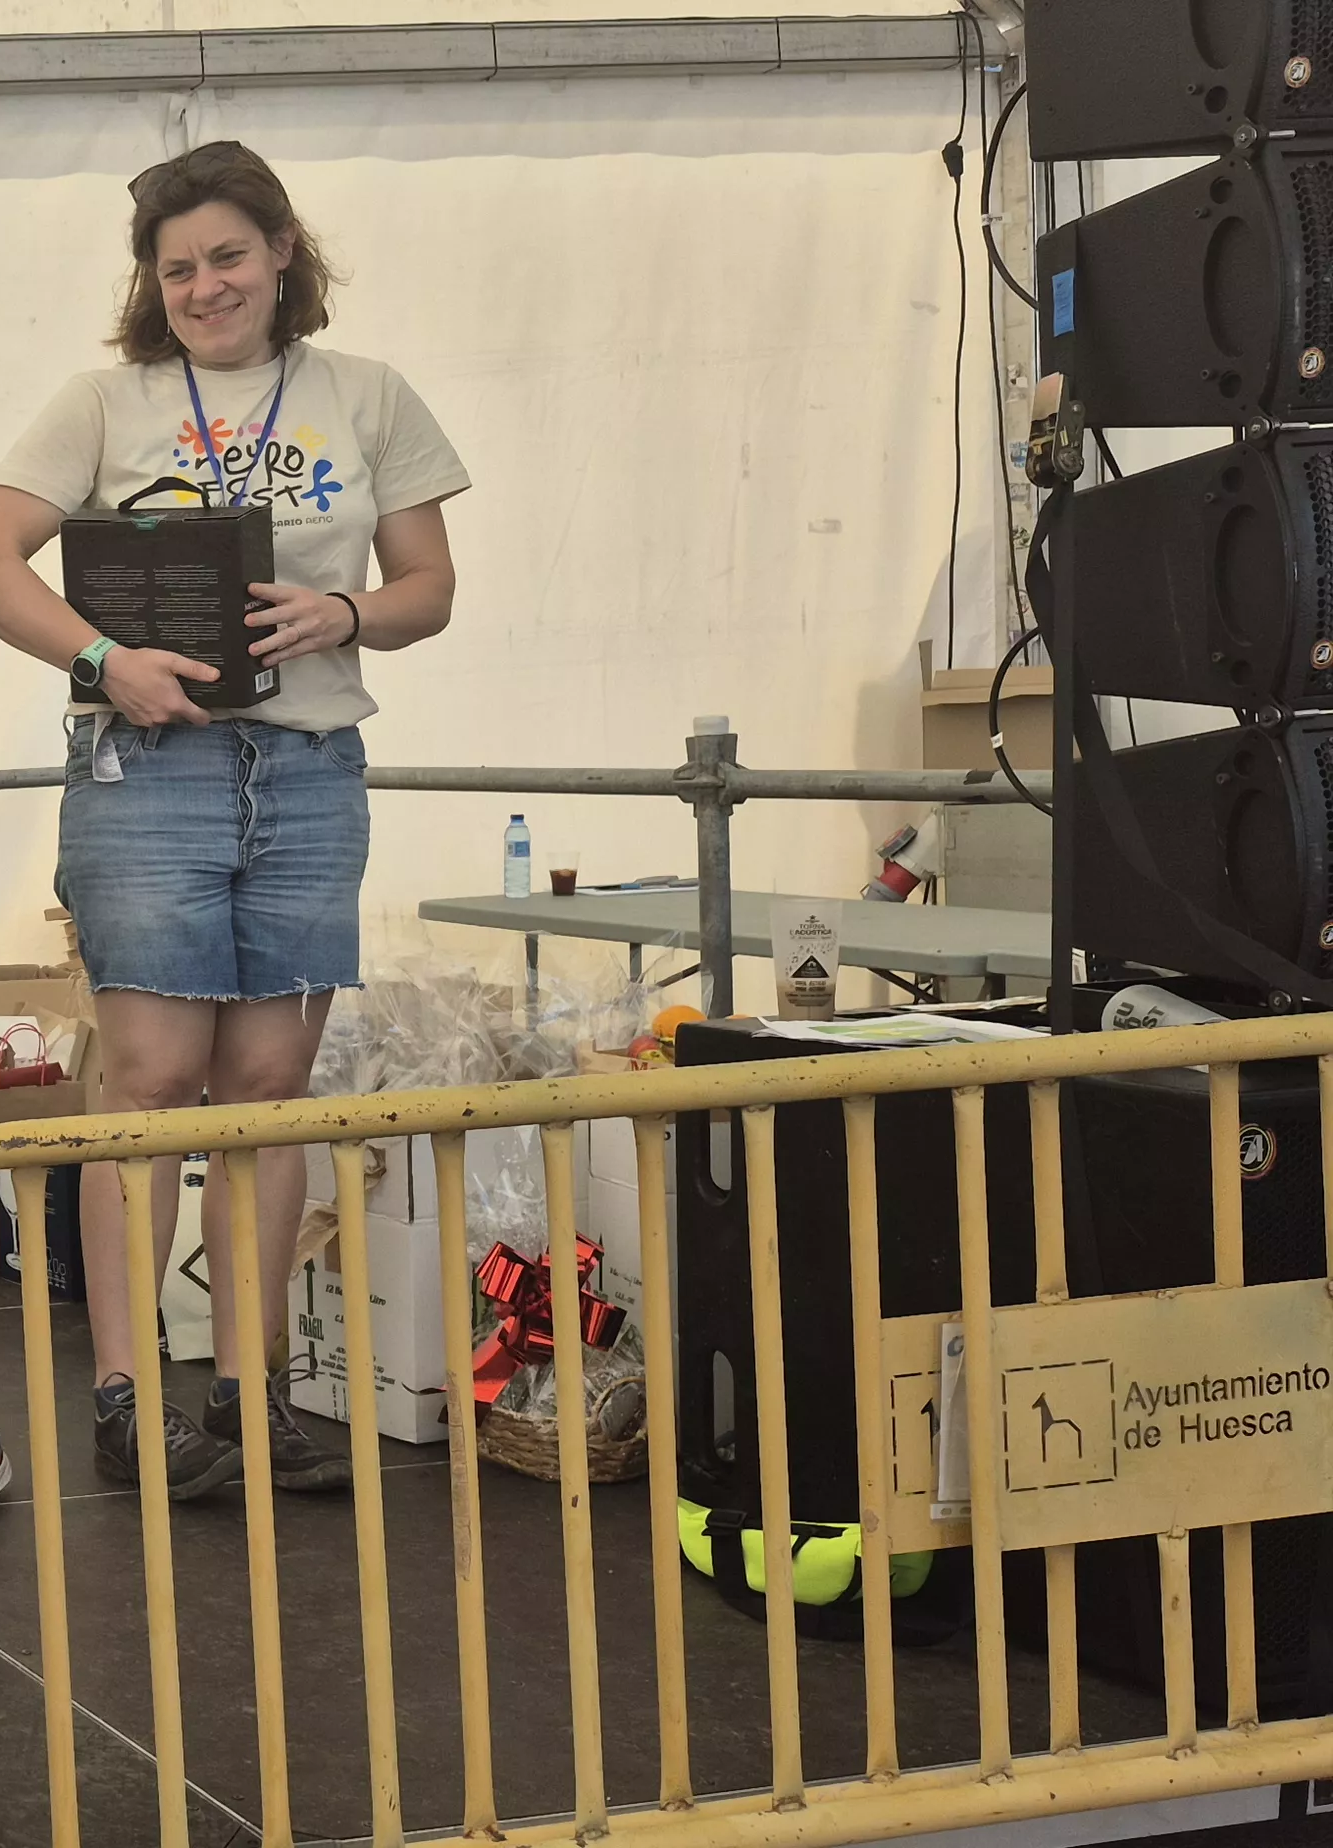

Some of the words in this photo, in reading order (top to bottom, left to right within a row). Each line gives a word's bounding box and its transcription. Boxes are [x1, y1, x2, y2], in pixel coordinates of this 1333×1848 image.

[1123, 1362, 1330, 1417] Ayuntamiento
[1123, 1420, 1161, 1450] de
[1179, 1409, 1293, 1444] Huesca
